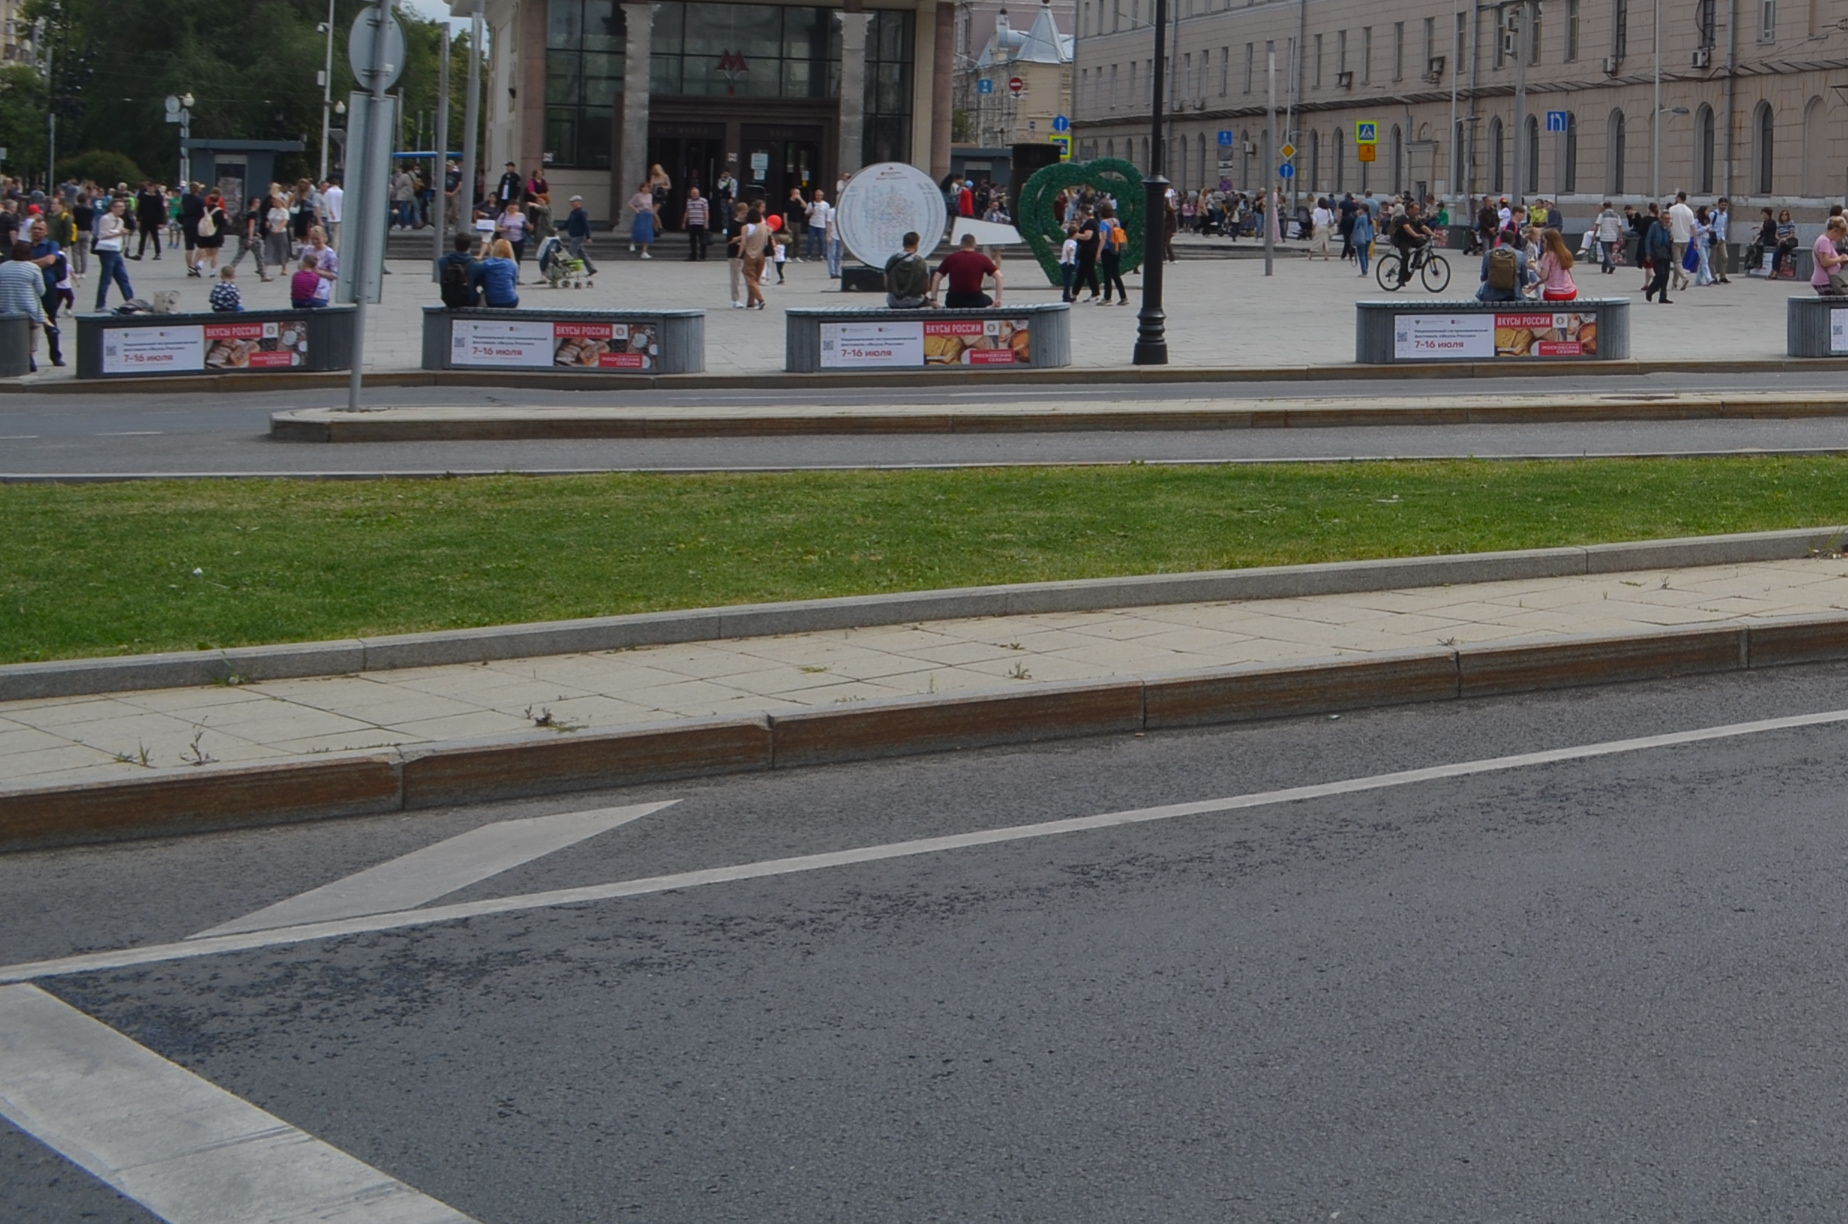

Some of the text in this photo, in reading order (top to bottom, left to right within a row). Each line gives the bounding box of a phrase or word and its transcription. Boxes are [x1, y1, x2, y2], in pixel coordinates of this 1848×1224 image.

[1497, 316, 1550, 326] ВКУСЫ РОССИИ
[556, 325, 610, 336] ВКУСЫ РОССИИ
[926, 323, 981, 334] ВКУСЫ РОССИИ
